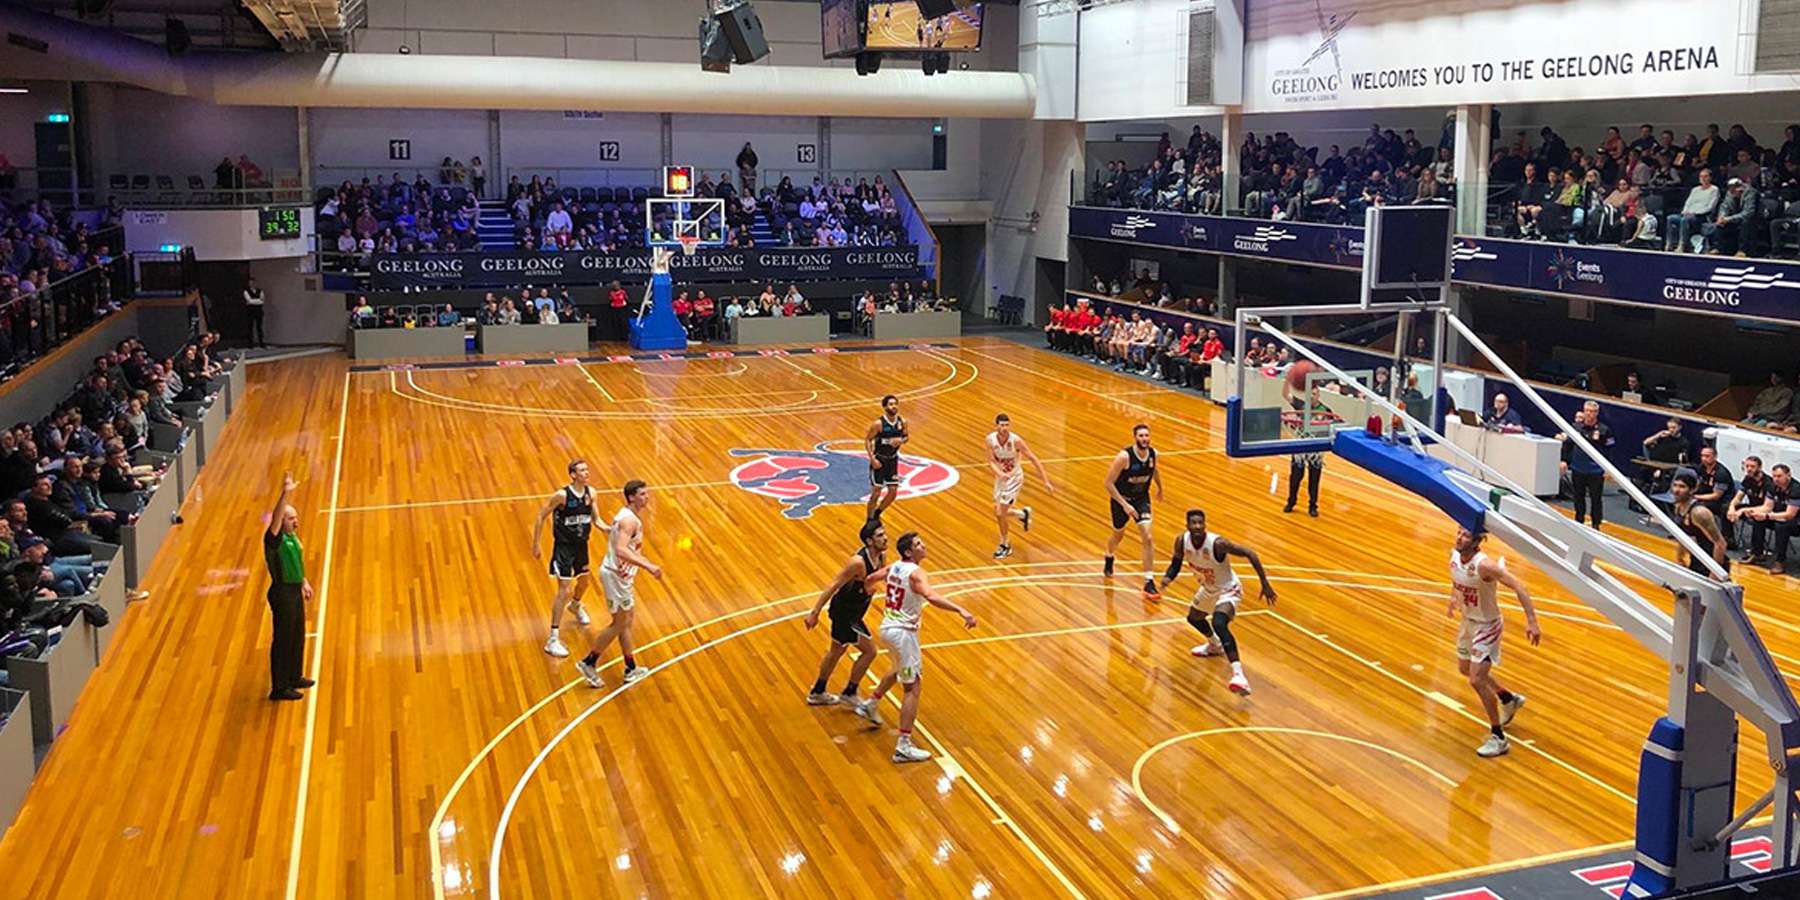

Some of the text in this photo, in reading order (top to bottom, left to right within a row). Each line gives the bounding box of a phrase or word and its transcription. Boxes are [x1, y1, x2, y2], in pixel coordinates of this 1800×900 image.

[1351, 45, 1719, 90] WELCOMES YOU TO THE GEELONG ARENA
[1272, 74, 1338, 95] GEELONG
[391, 142, 408, 158] 11
[601, 143, 618, 160] 12
[799, 146, 814, 162] 13
[287, 220, 299, 232] 32
[481, 257, 564, 271] GEELONG
[670, 254, 744, 268] GEELONG
[759, 254, 832, 266] GEELONG
[846, 252, 915, 265] GEELONG
[377, 259, 464, 273] GEELONG
[1577, 261, 1600, 273] Events
[1576, 270, 1604, 284] Geelong
[1663, 284, 1740, 306] GEELONG
[885, 583, 905, 611] 53
